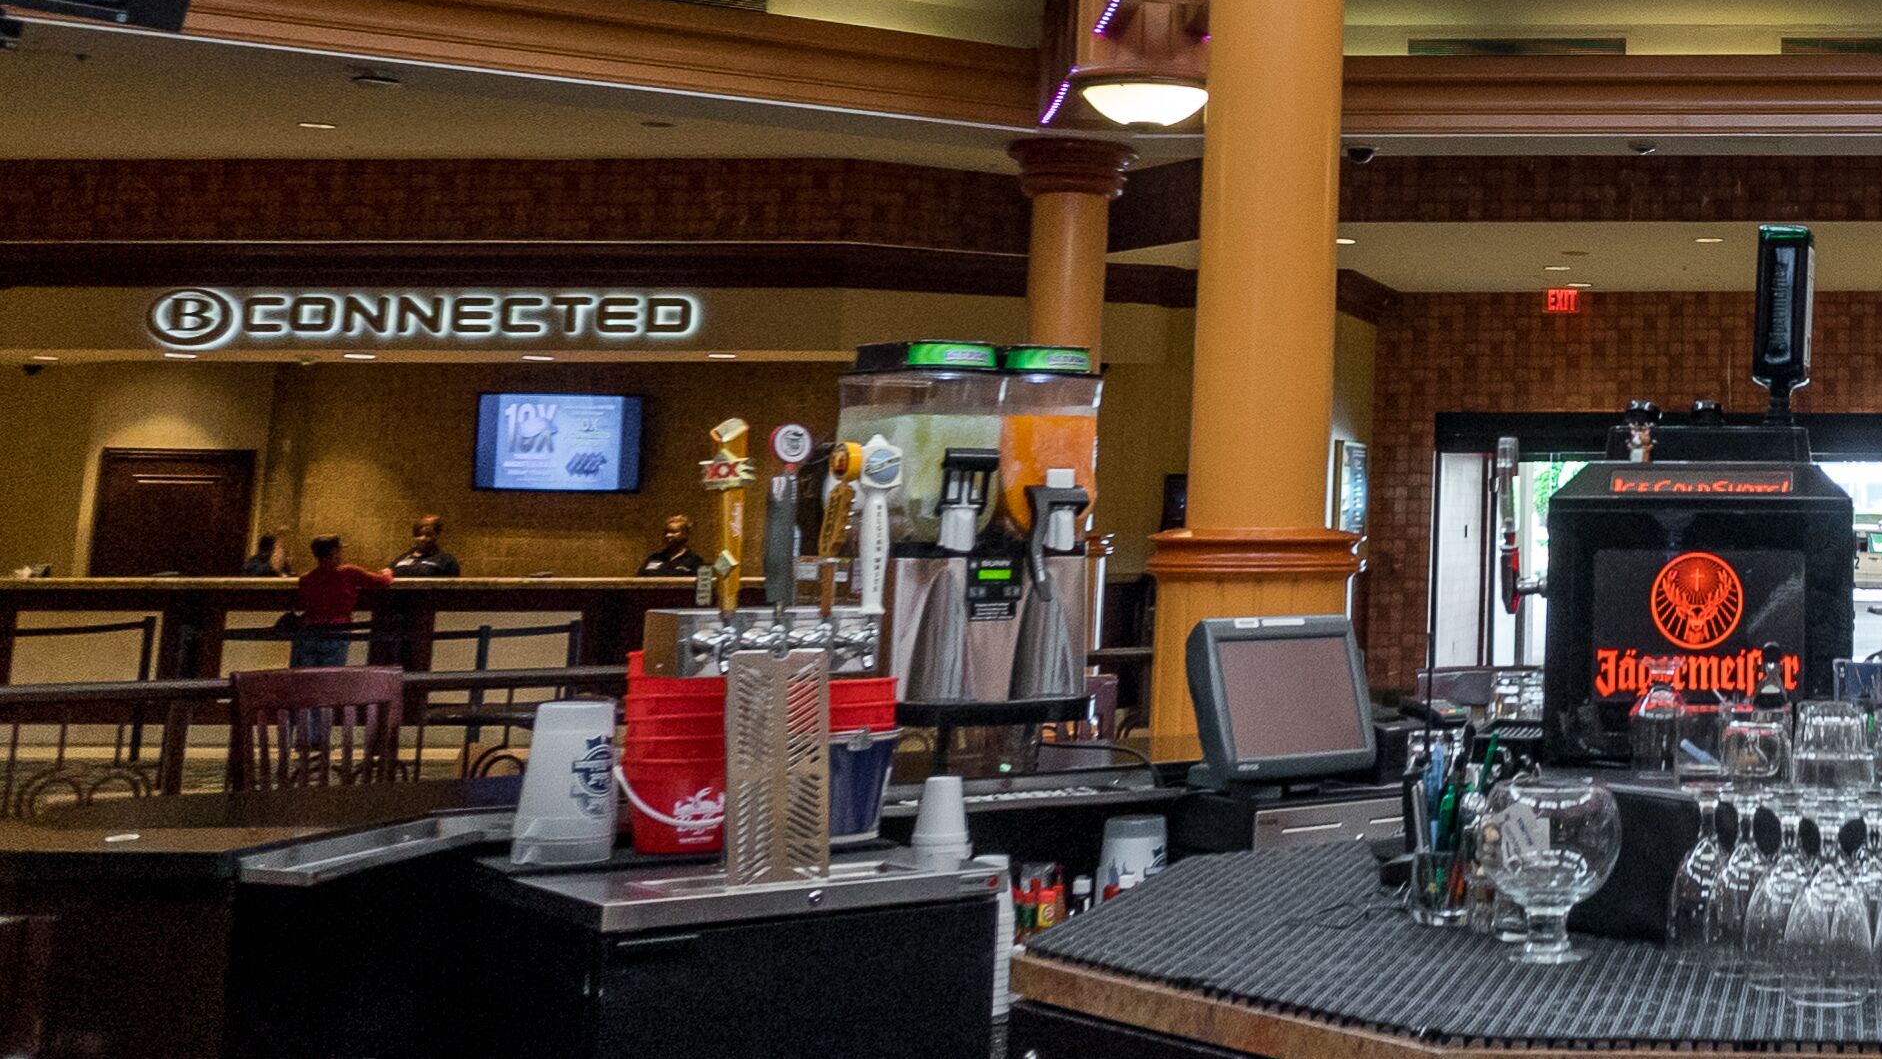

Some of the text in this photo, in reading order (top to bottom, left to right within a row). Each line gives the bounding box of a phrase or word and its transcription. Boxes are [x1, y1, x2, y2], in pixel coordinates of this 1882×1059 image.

[242, 295, 695, 336] CONNECTED
[1547, 288, 1577, 311] EXIT
[1594, 648, 1800, 698] Jägrmeisr
